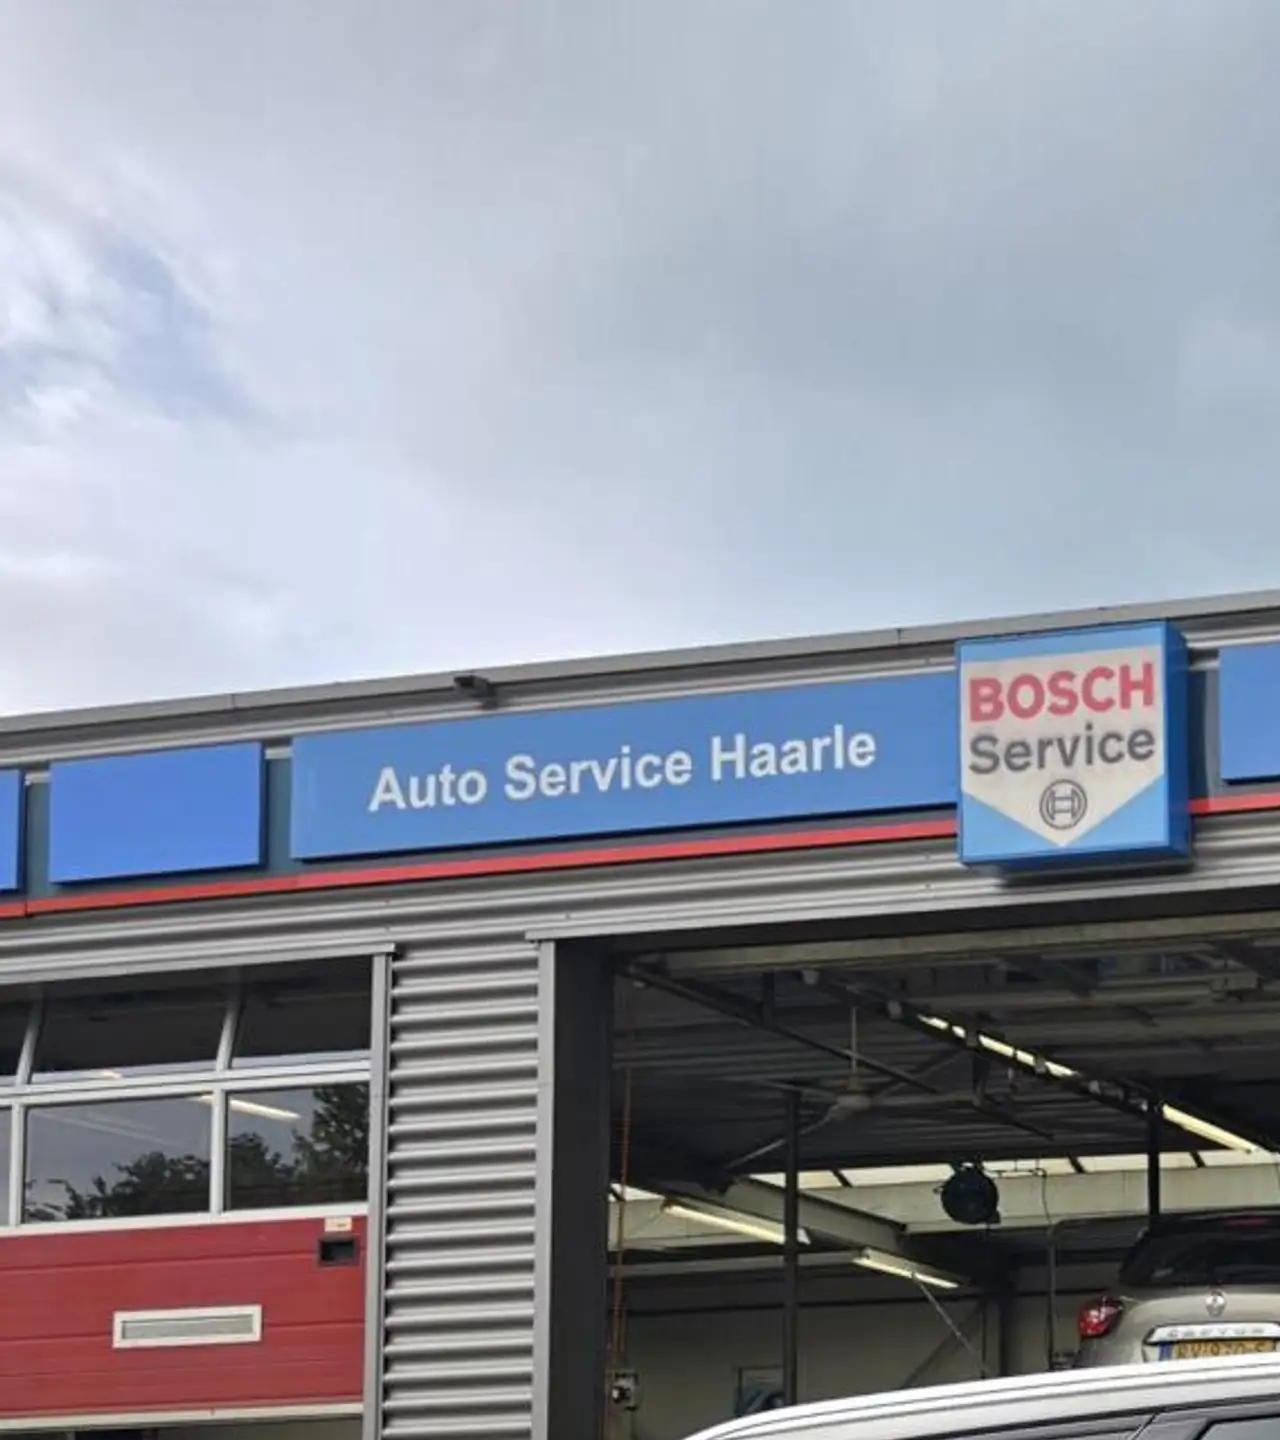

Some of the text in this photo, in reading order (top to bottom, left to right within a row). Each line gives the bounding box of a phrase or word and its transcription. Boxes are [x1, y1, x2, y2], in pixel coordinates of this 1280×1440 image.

[969, 662, 1155, 722] BOSCH
[367, 724, 877, 812] Auto Service Haarle
[968, 721, 1155, 775] Service
